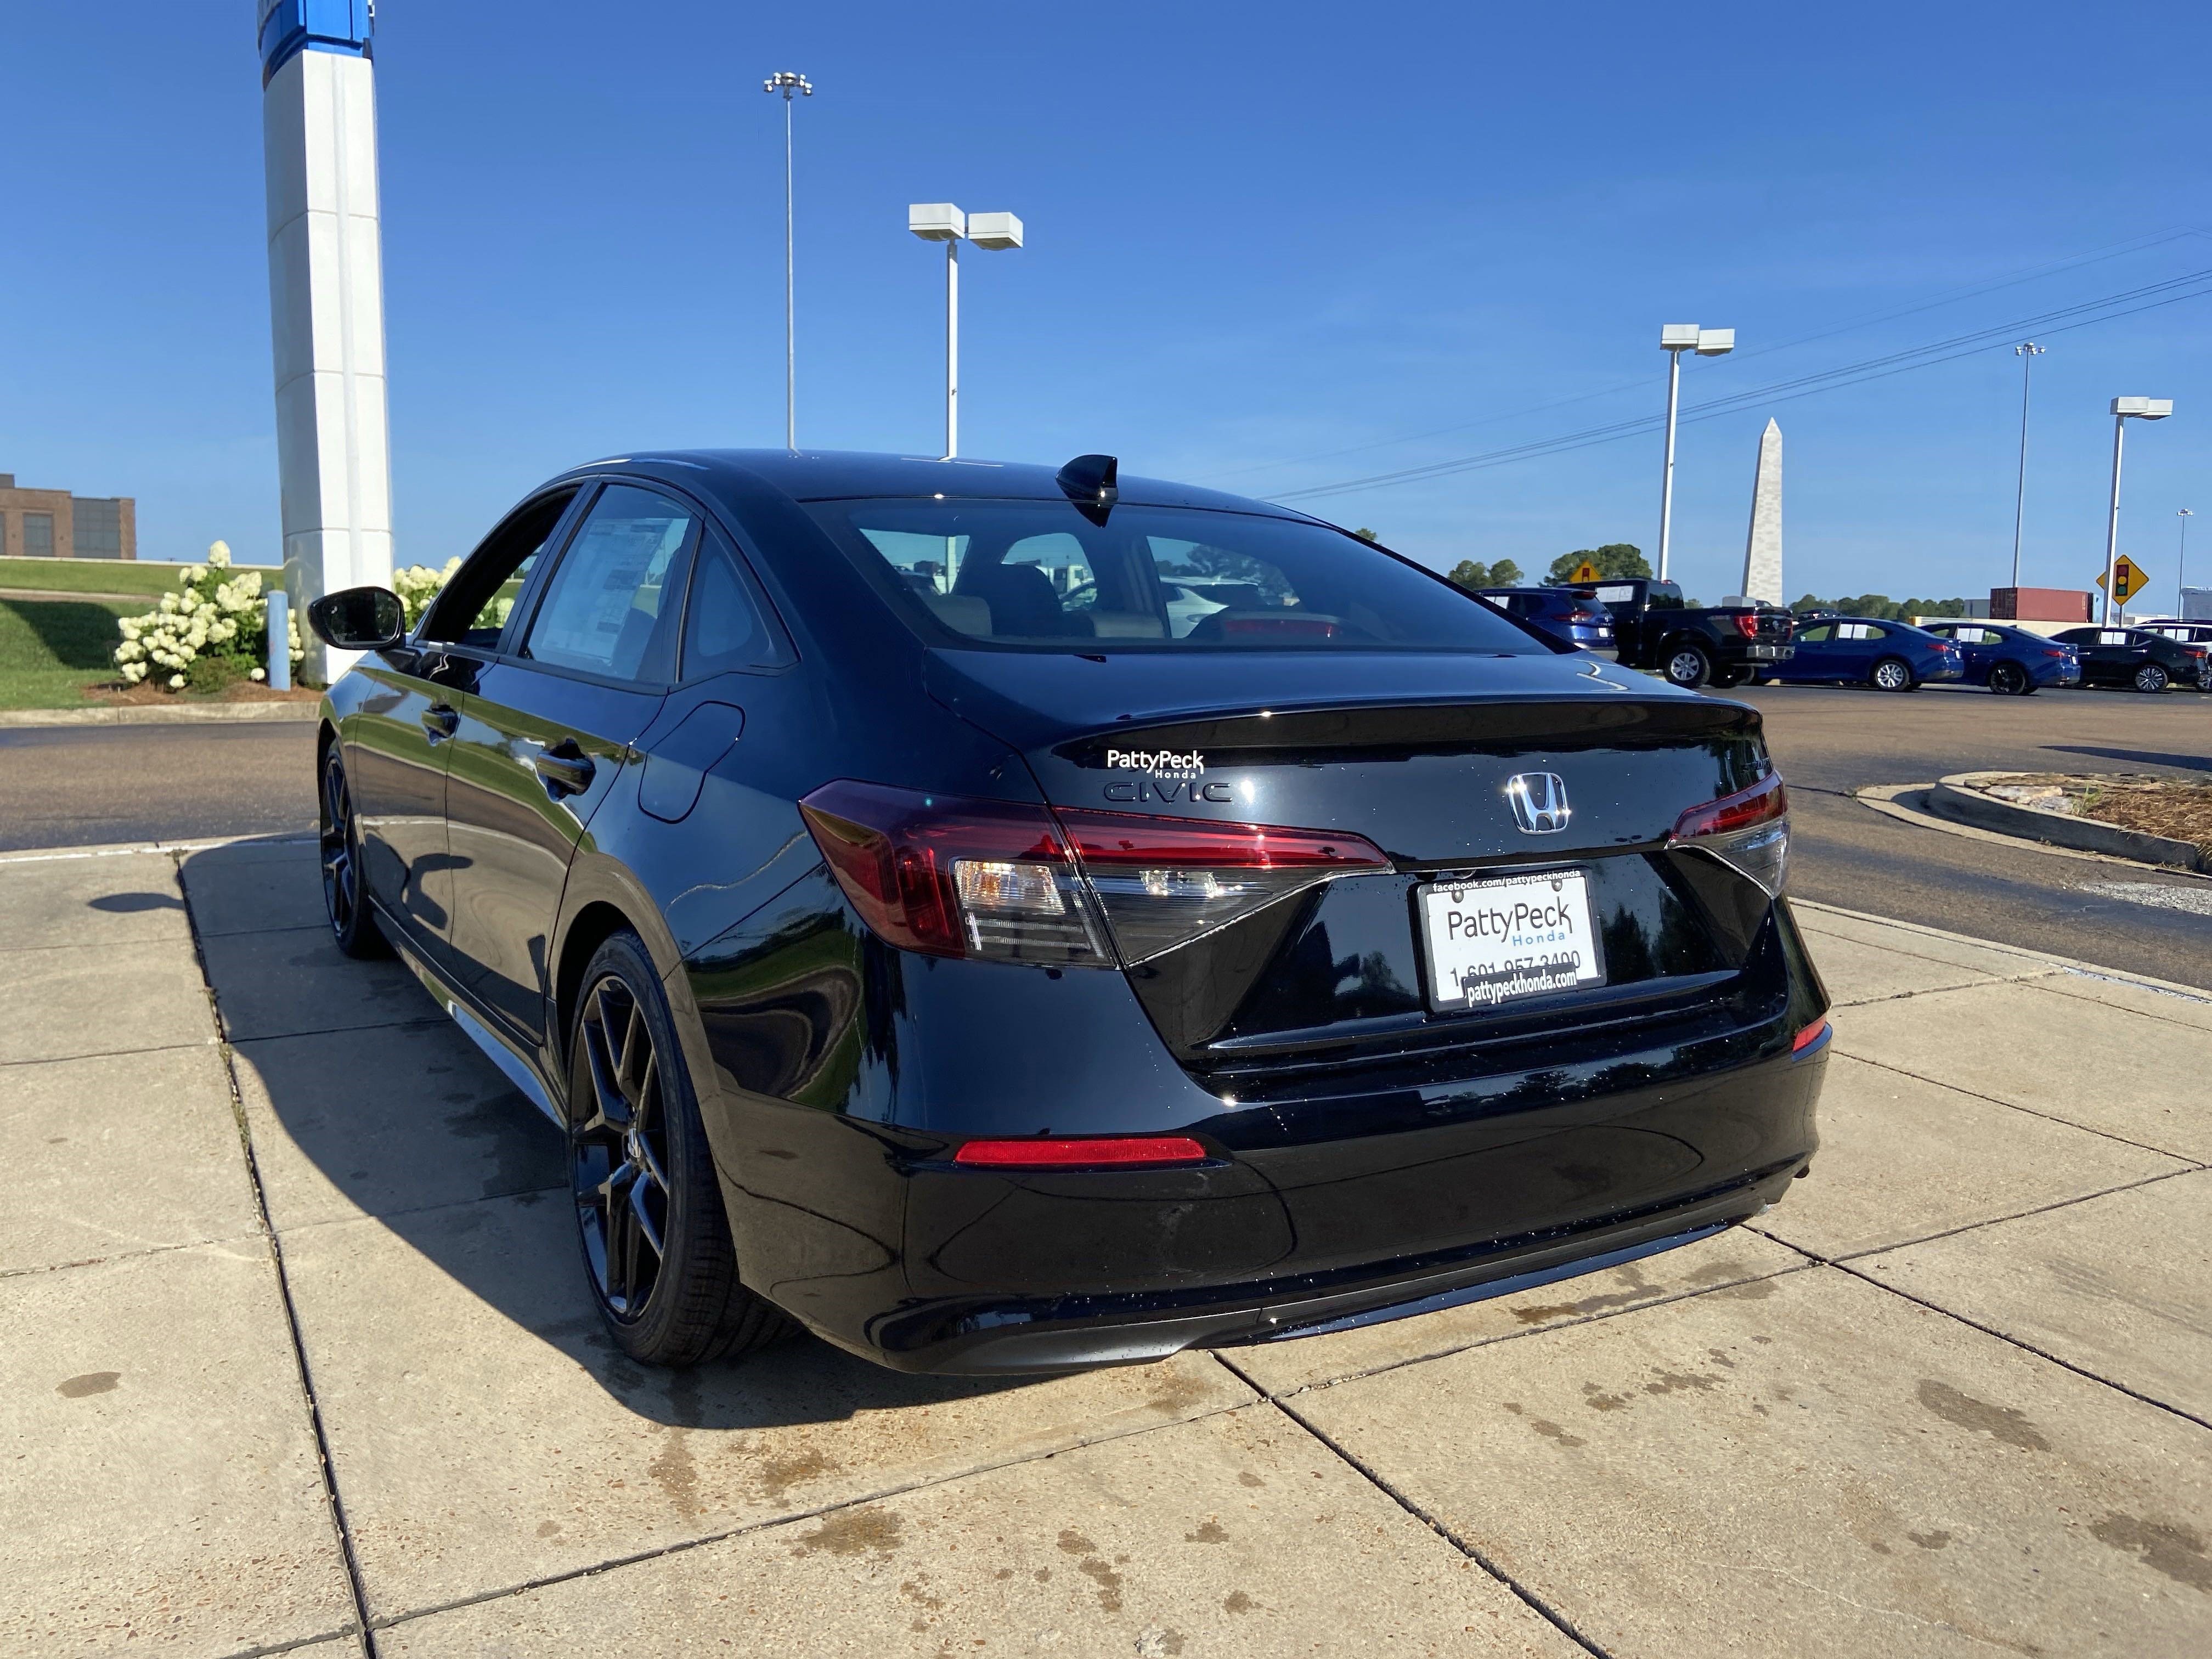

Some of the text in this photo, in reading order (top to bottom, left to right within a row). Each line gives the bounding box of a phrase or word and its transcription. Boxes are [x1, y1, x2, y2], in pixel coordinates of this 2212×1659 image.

[1107, 749, 1204, 775] PattyPeck
[1155, 770, 1197, 779] Honda
[1103, 782, 1233, 803] CIVIC
[1447, 895, 1573, 943] PattyPeck
[1512, 929, 1565, 947] Honda
[1466, 968, 1577, 1008] pattypeckhonda.com
